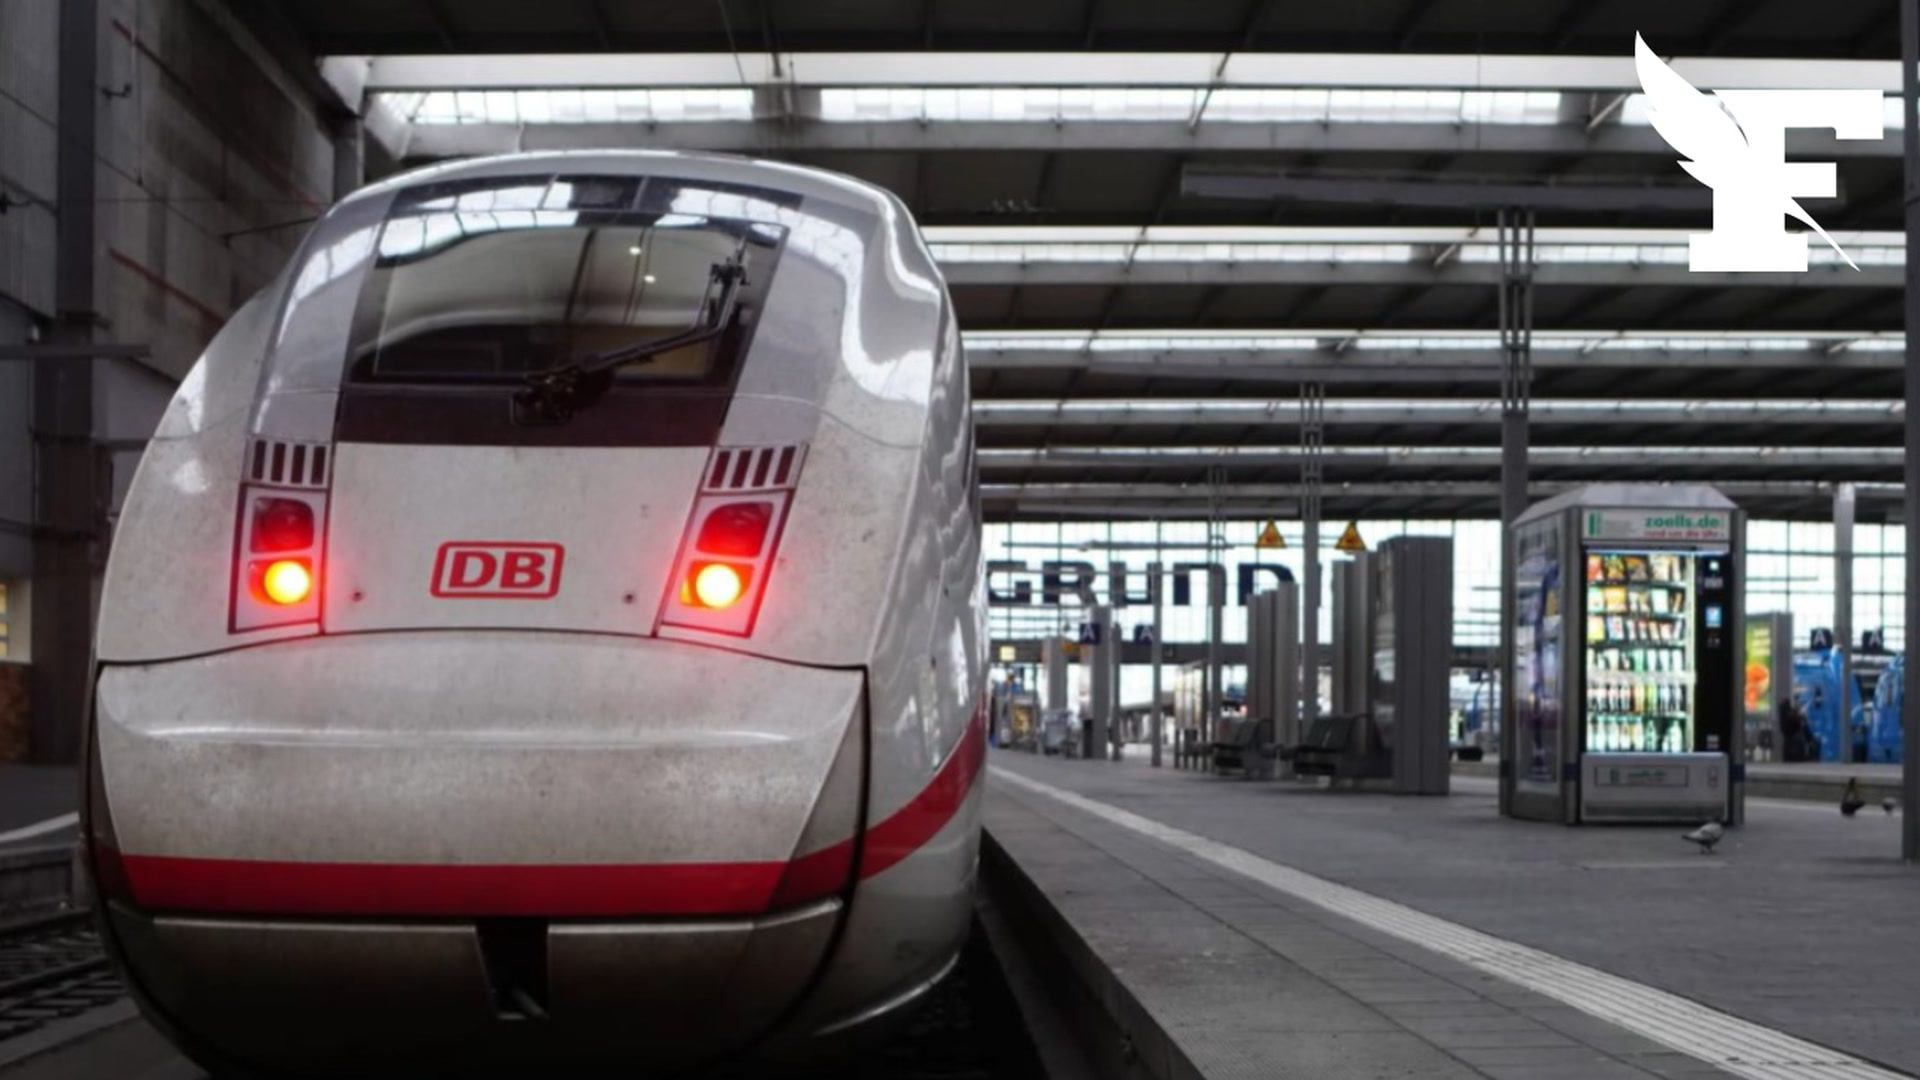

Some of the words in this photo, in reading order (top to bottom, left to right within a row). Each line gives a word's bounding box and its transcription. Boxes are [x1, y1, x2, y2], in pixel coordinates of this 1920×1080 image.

[1644, 514, 1720, 528] zoells.de
[448, 551, 545, 588] DB
[987, 561, 1321, 607] GRUND
